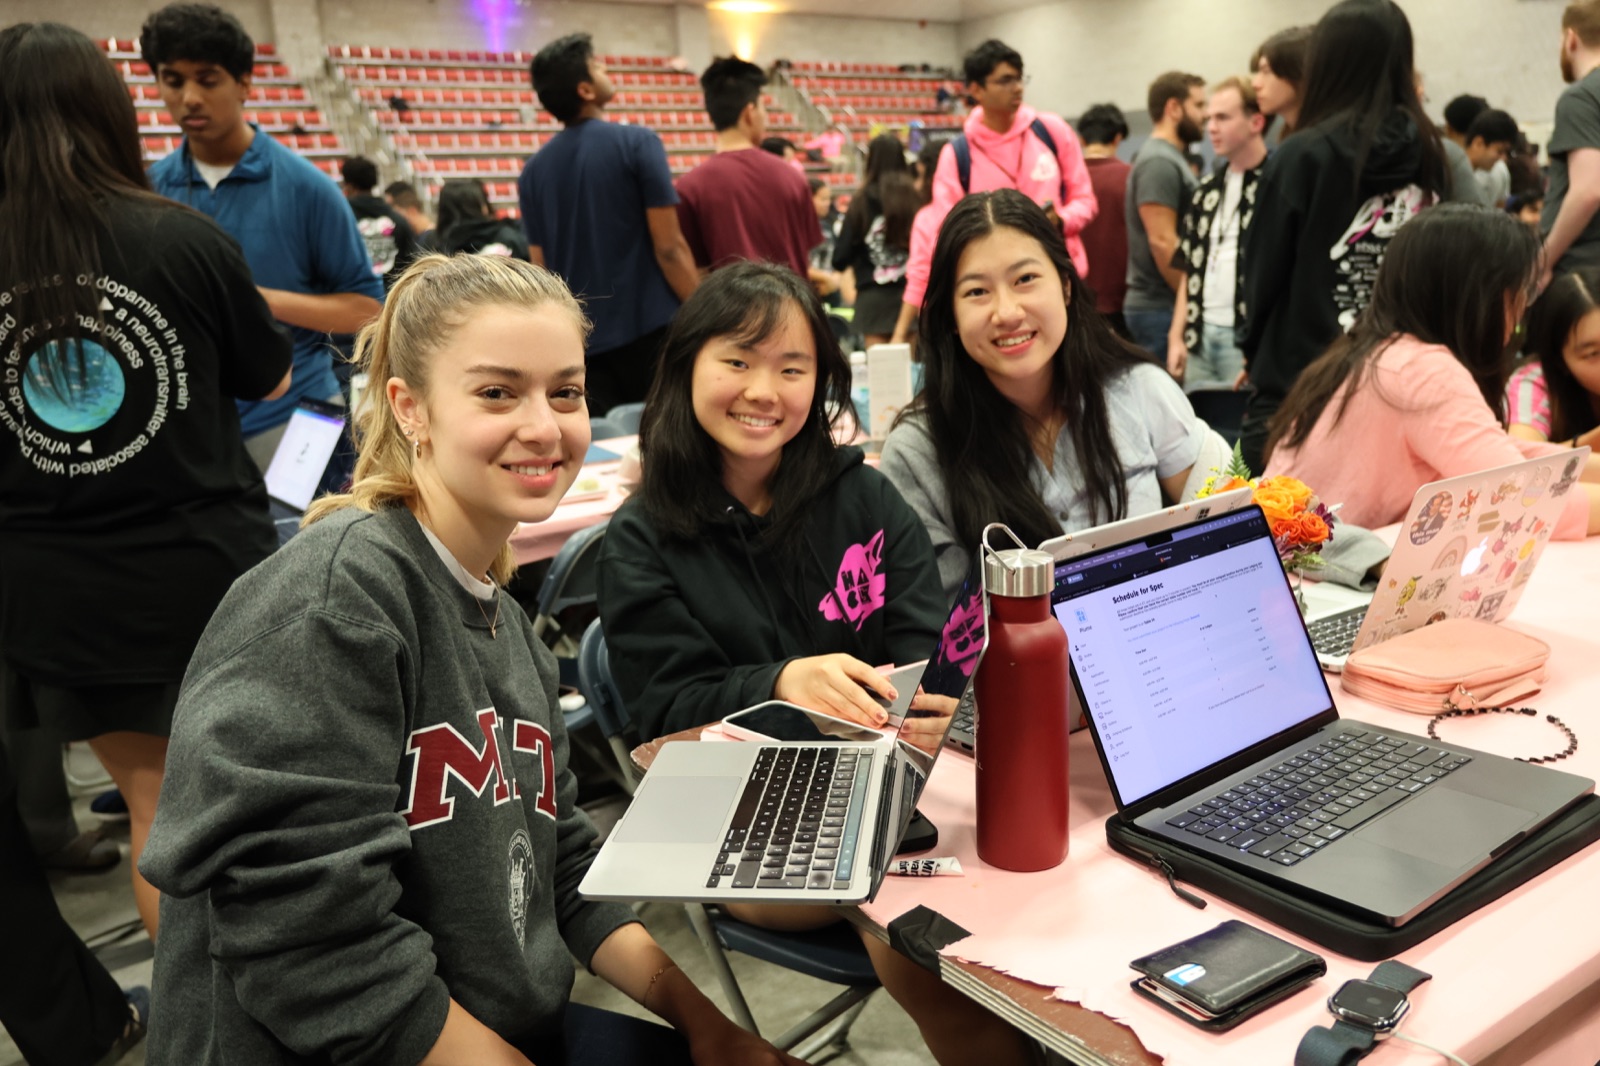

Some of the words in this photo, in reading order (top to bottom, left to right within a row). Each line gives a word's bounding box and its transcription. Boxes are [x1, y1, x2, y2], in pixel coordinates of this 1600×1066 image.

[96, 275, 168, 330] dopamine
[115, 308, 128, 321] a
[163, 328, 178, 345] in
[170, 345, 186, 370] the
[4, 368, 19, 384] to
[126, 317, 169, 437] neurotransmitter
[176, 372, 190, 410] brain
[24, 426, 72, 455] which
[32, 453, 65, 475] with
[69, 434, 149, 478] associated
[1112, 588, 1139, 605] Schedule
[1139, 585, 1149, 597] for
[1149, 582, 1164, 595] Spec
